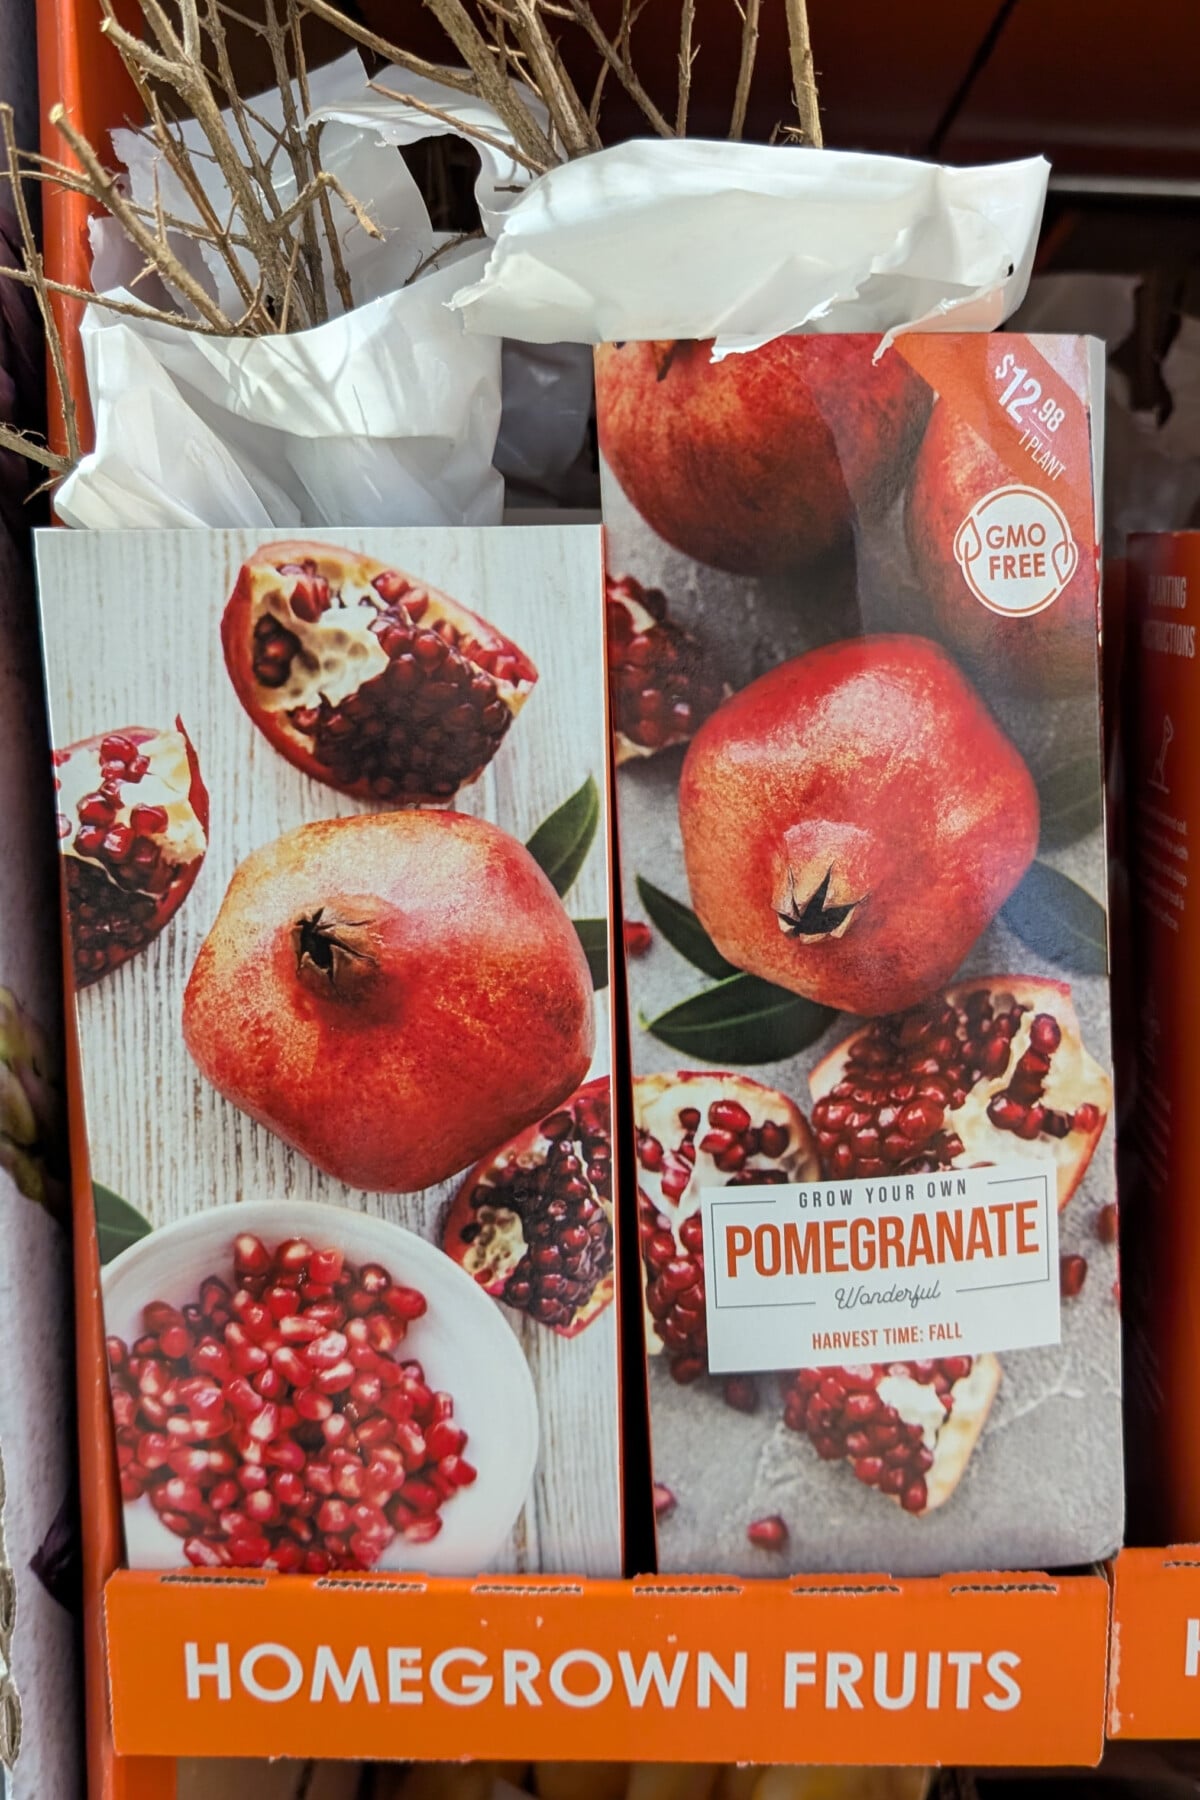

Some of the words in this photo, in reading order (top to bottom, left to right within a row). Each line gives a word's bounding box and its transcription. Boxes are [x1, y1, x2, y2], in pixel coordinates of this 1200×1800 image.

[995, 353, 1066, 432] $12.98
[1018, 428, 1031, 446] 1
[1024, 435, 1067, 481] PLANT
[985, 523, 1047, 549] GMO
[988, 553, 1047, 580] FREE
[799, 1189, 853, 1208] GROW
[866, 1183, 914, 1203] YOUR
[927, 1178, 968, 1198] OWN
[725, 1200, 1040, 1278] POMEGRANATE
[834, 1280, 941, 1309] Wonderful
[812, 1329, 878, 1350] HARVEST
[883, 1326, 924, 1345] TIME:
[929, 1322, 963, 1341] FALL
[184, 1641, 748, 1709] HOMEGROWN
[783, 1649, 1022, 1712] FRUITS
